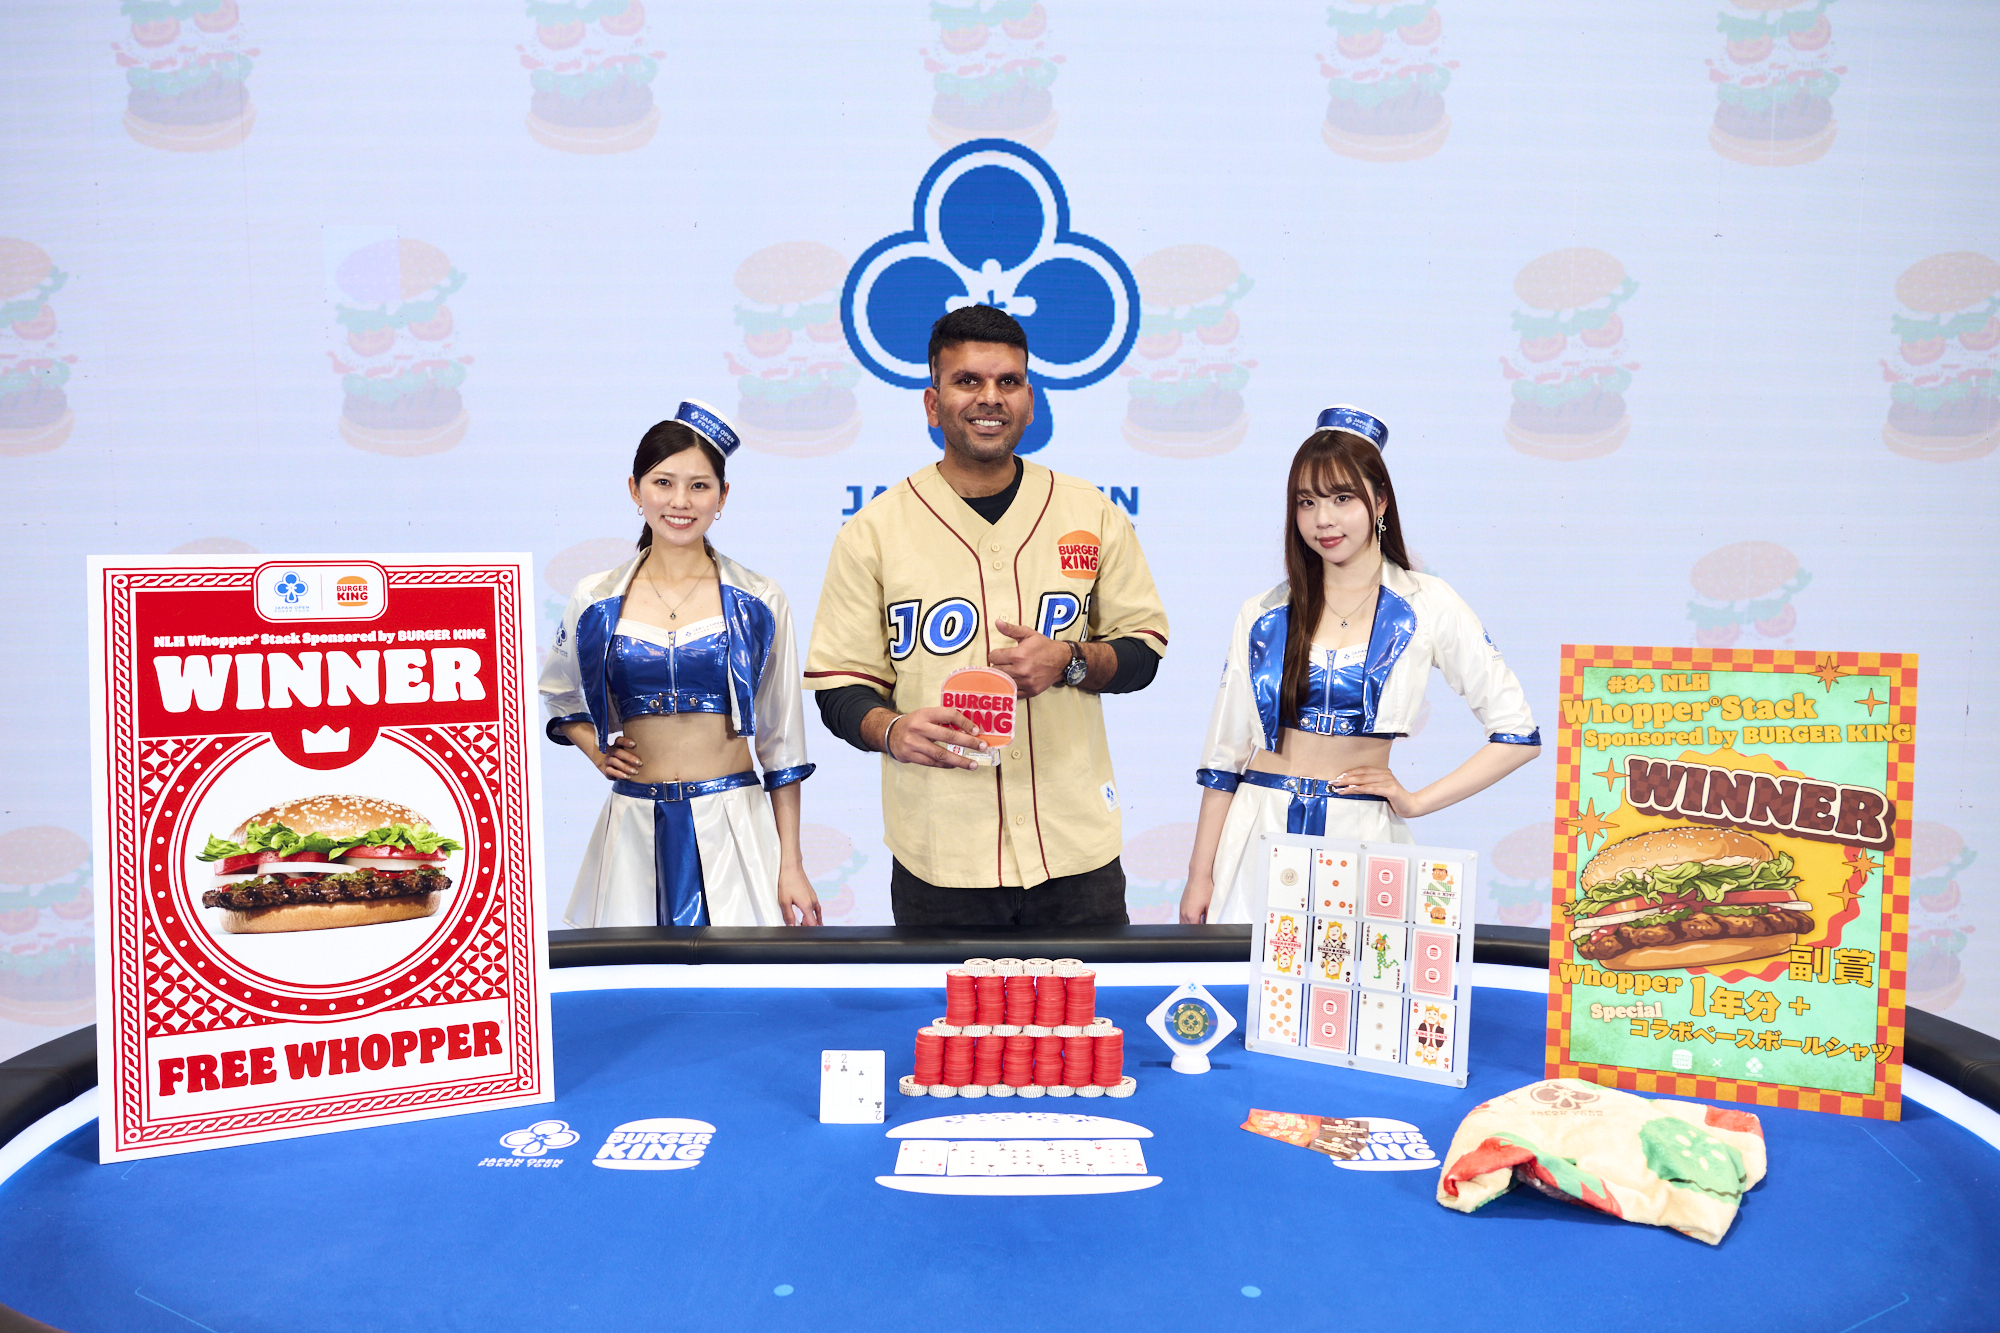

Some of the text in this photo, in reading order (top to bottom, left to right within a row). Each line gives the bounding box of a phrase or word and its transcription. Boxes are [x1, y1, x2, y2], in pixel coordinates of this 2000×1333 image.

[700, 415, 735, 443] JAPAN OPEN
[1058, 545, 1098, 557] BURGER
[1061, 555, 1098, 570] KING
[337, 592, 368, 600] KING
[154, 634, 186, 648] NLH
[261, 631, 301, 645] Stack
[302, 630, 377, 646] Sponsored
[378, 630, 396, 645] by
[398, 629, 451, 642] BURGER
[153, 647, 487, 713] WINNER
[1607, 673, 1710, 693] #84 NLH
[943, 692, 1014, 712] BURGER
[1721, 693, 1818, 721] Stack
[1584, 723, 1912, 751] Sponsored by BURGER KING
[1625, 754, 1889, 845] WINNER
[1789, 944, 1876, 988] 副賞
[1559, 963, 1683, 996] Whopper
[1690, 976, 1782, 1023] 1年分
[1590, 1000, 1663, 1022] Special
[1630, 1019, 1895, 1064] コラボベースボールシャツ
[824, 1052, 848, 1063] 2 2
[159, 1047, 277, 1097] FREE
[605, 1132, 713, 1145] BURGER
[596, 1144, 708, 1160] KING
[1330, 1143, 1436, 1160] ING
